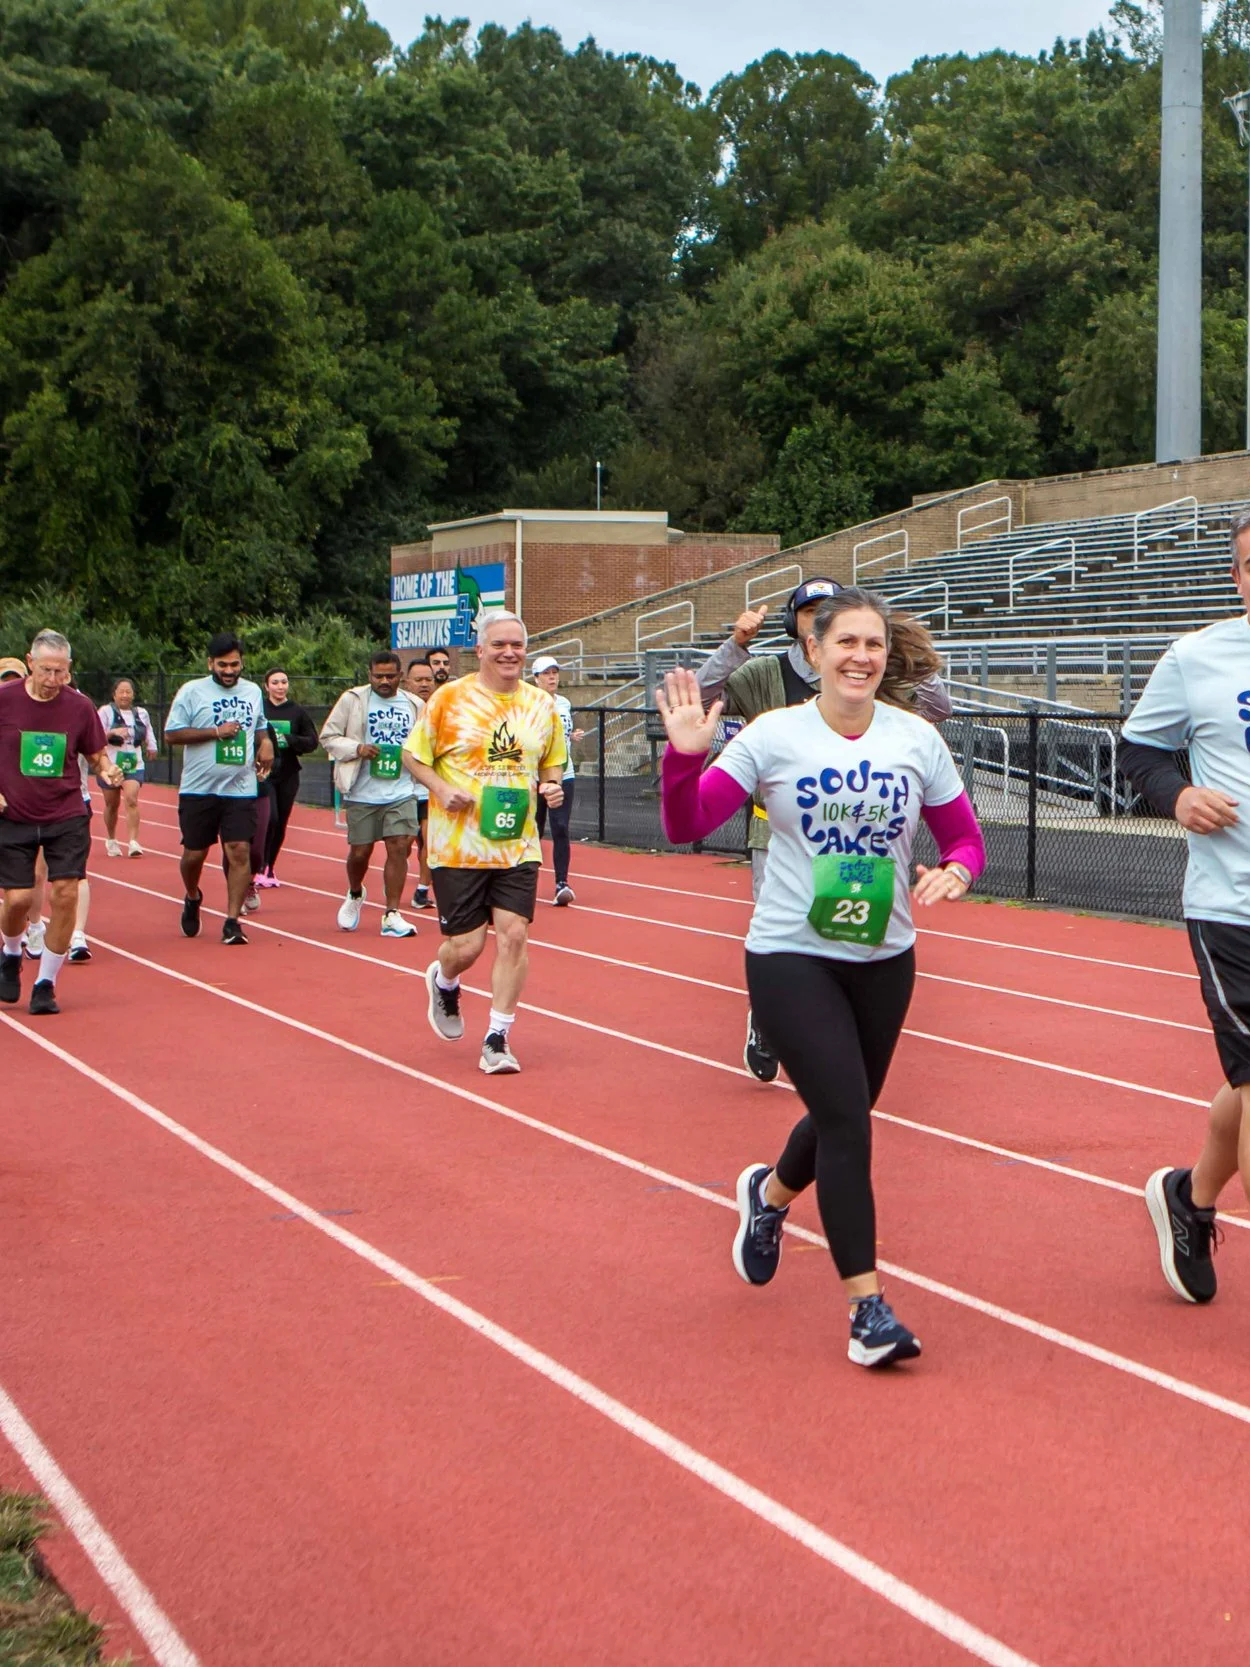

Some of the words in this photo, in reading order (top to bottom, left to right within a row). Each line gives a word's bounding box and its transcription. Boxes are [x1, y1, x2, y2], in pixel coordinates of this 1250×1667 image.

[393, 573, 419, 601] HOME
[420, 572, 434, 598] OF
[435, 569, 456, 597] THE
[396, 619, 451, 649] SEAHAWKS
[213, 696, 254, 716] SOUTH
[368, 706, 409, 727] SOUTH
[32, 752, 54, 768] 49
[223, 746, 243, 757] 115
[377, 760, 397, 771] 114
[796, 760, 909, 813] SOUTH
[495, 812, 516, 829] 65
[801, 816, 906, 857] LAKES
[831, 899, 871, 926] 23
